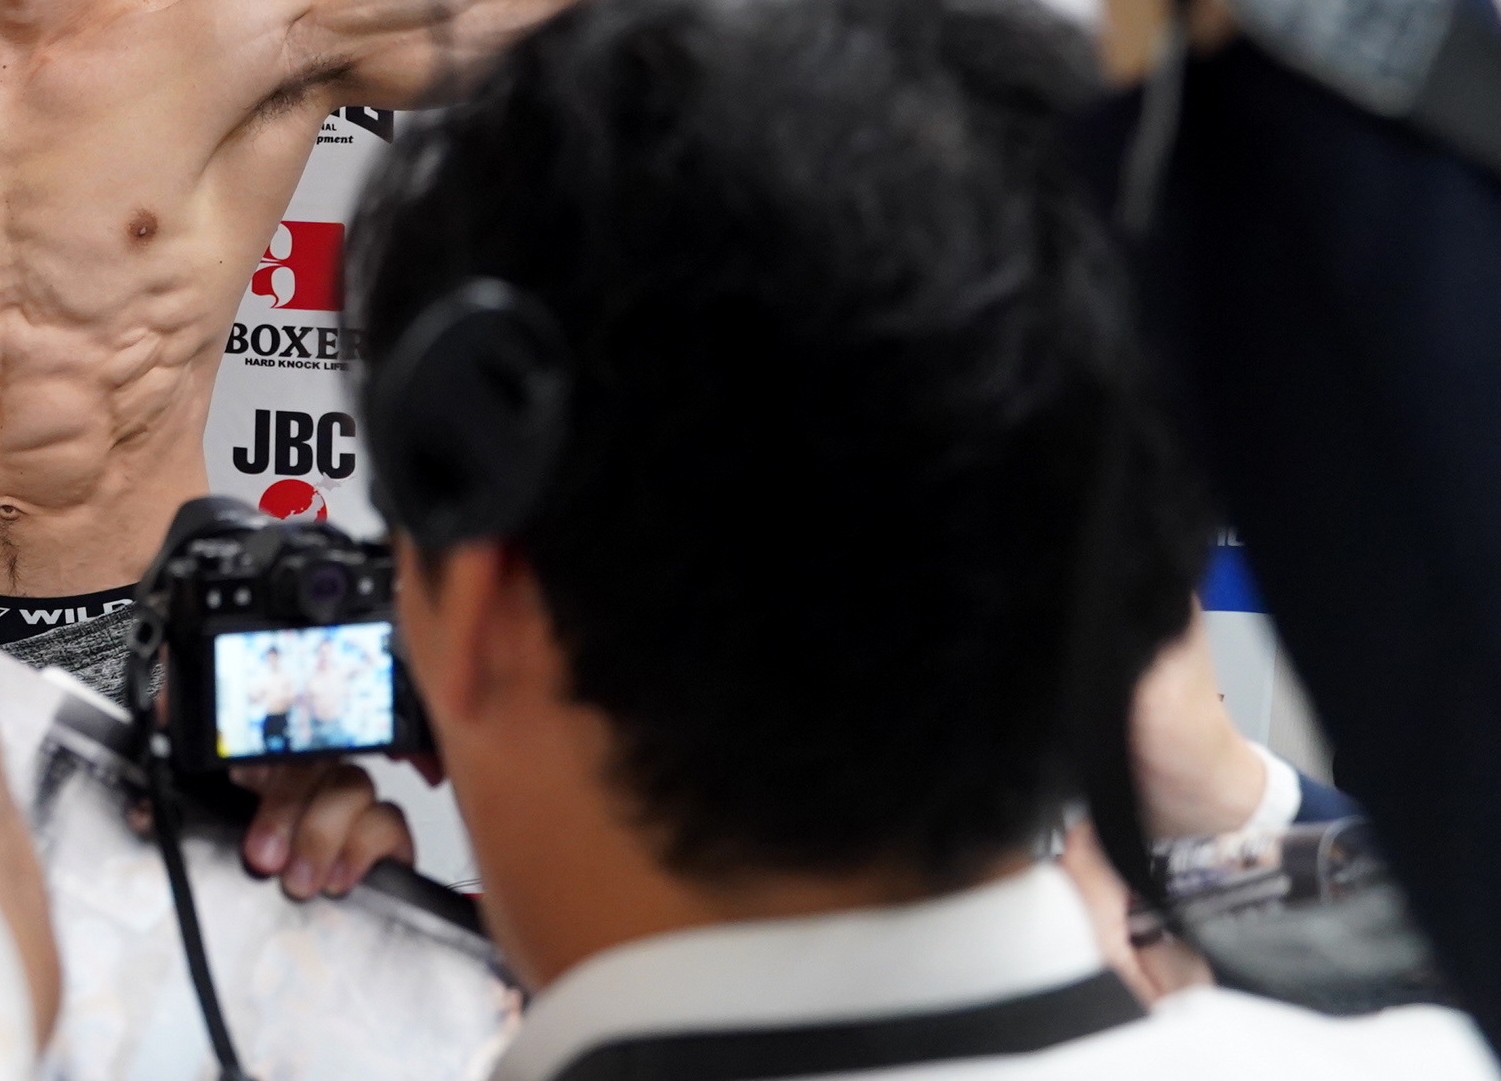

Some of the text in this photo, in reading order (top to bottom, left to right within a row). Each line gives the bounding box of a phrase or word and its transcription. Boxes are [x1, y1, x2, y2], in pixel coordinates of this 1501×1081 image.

[245, 358, 275, 367] HARD
[278, 360, 321, 370] KNOCK
[233, 411, 355, 478] JBC
